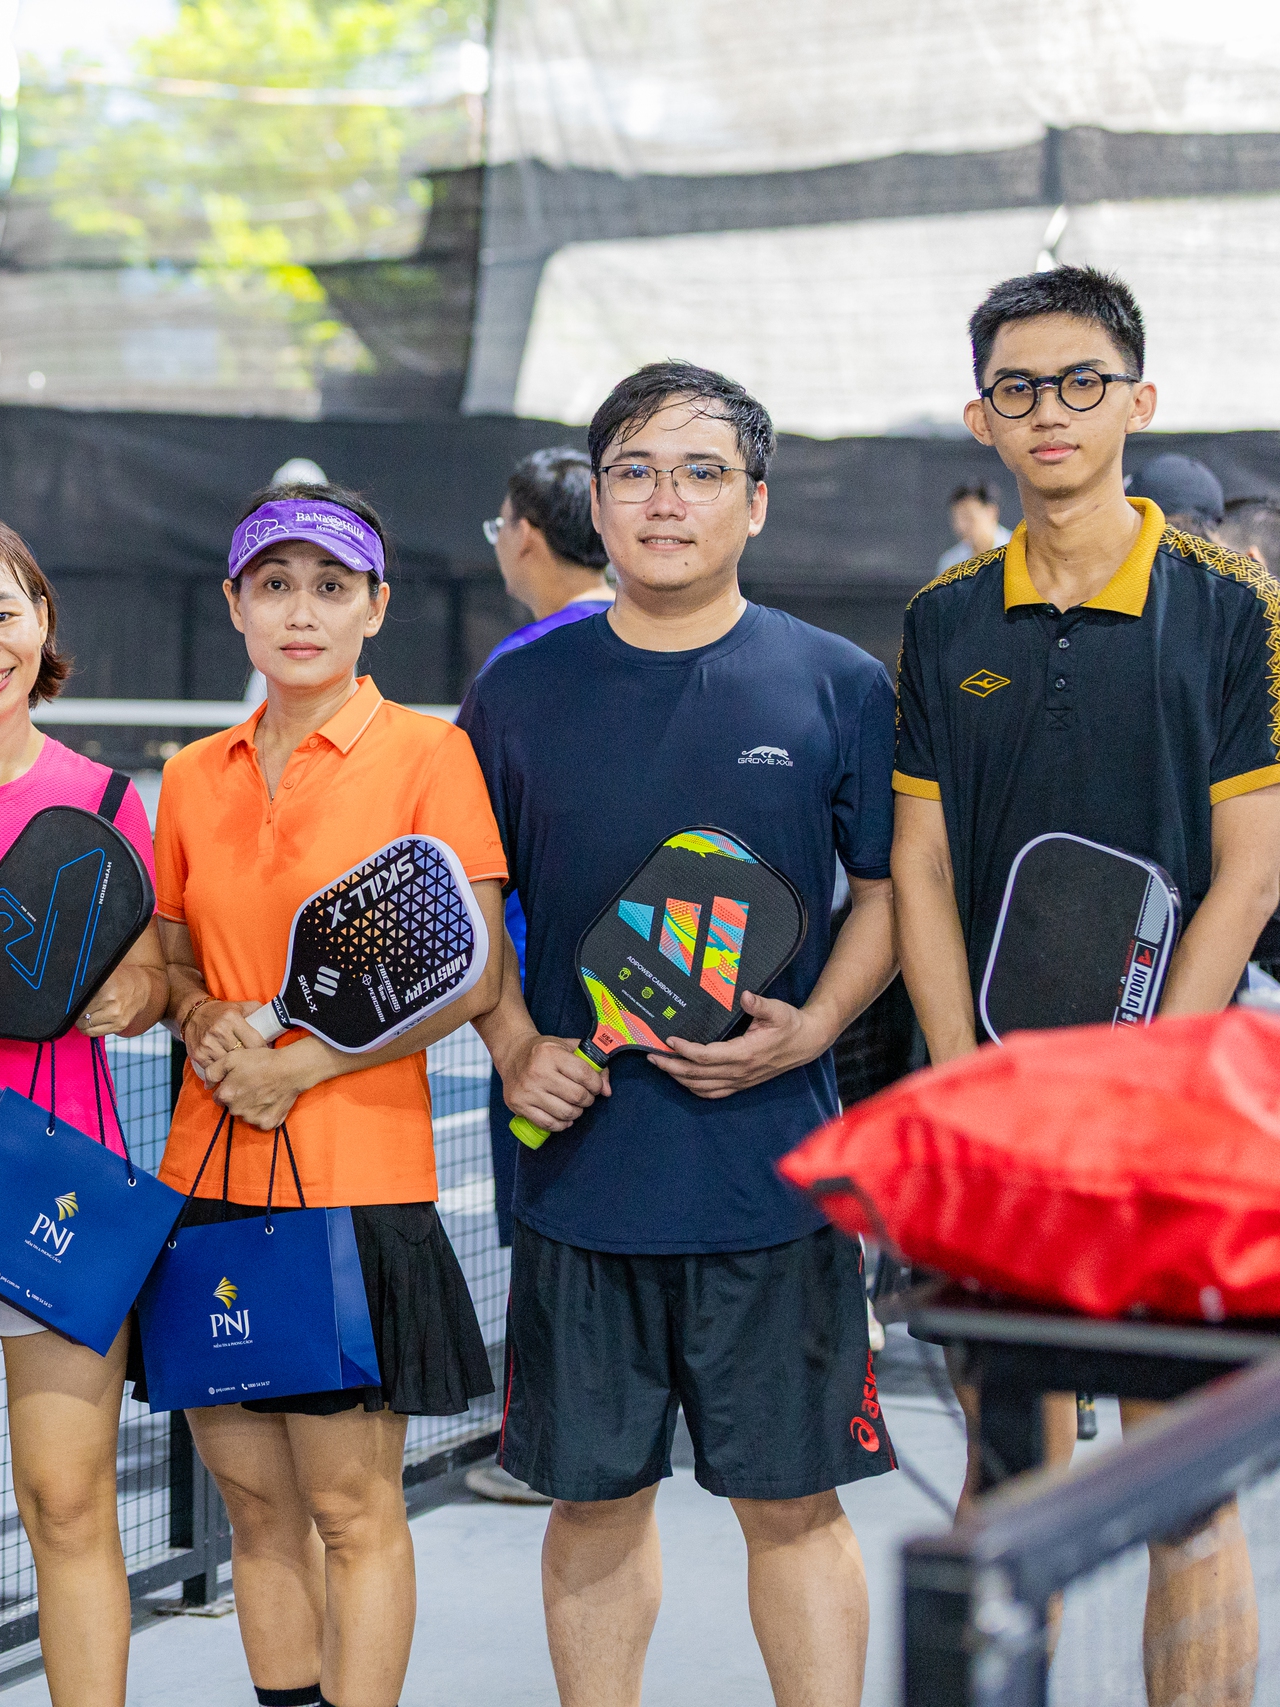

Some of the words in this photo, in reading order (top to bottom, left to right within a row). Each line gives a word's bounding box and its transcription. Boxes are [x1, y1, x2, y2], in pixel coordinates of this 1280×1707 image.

[99, 861, 112, 905] HYPERION
[377, 963, 401, 1010] FIBERGLASS
[404, 953, 468, 1005] MASTERY
[626, 955, 654, 979] ADIPOWER
[651, 976, 674, 996] CARBON
[672, 993, 687, 1008] TEAM
[1126, 966, 1148, 1009] JOOLA
[602, 1033, 614, 1044] USA
[30, 1212, 75, 1256] PNJ
[209, 1309, 250, 1340] PNJ
